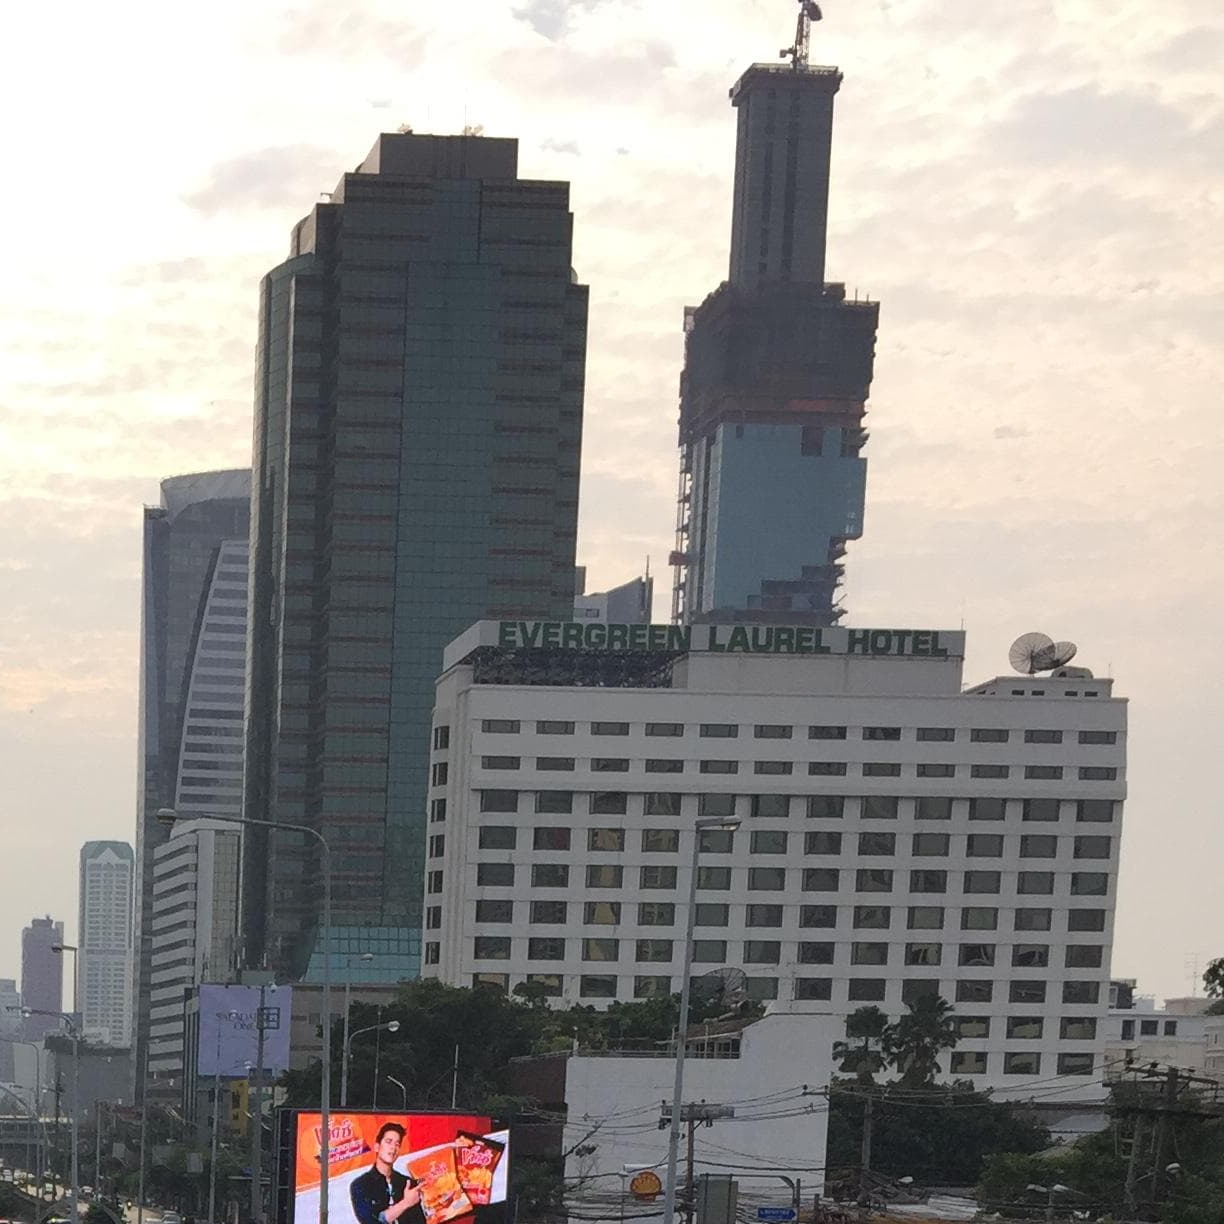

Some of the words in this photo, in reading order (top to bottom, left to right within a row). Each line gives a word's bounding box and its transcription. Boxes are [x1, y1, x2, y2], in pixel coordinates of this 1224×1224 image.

[498, 620, 692, 651] EVERGREEN
[707, 626, 832, 653] LAUREL
[847, 629, 949, 656] HOTEL
